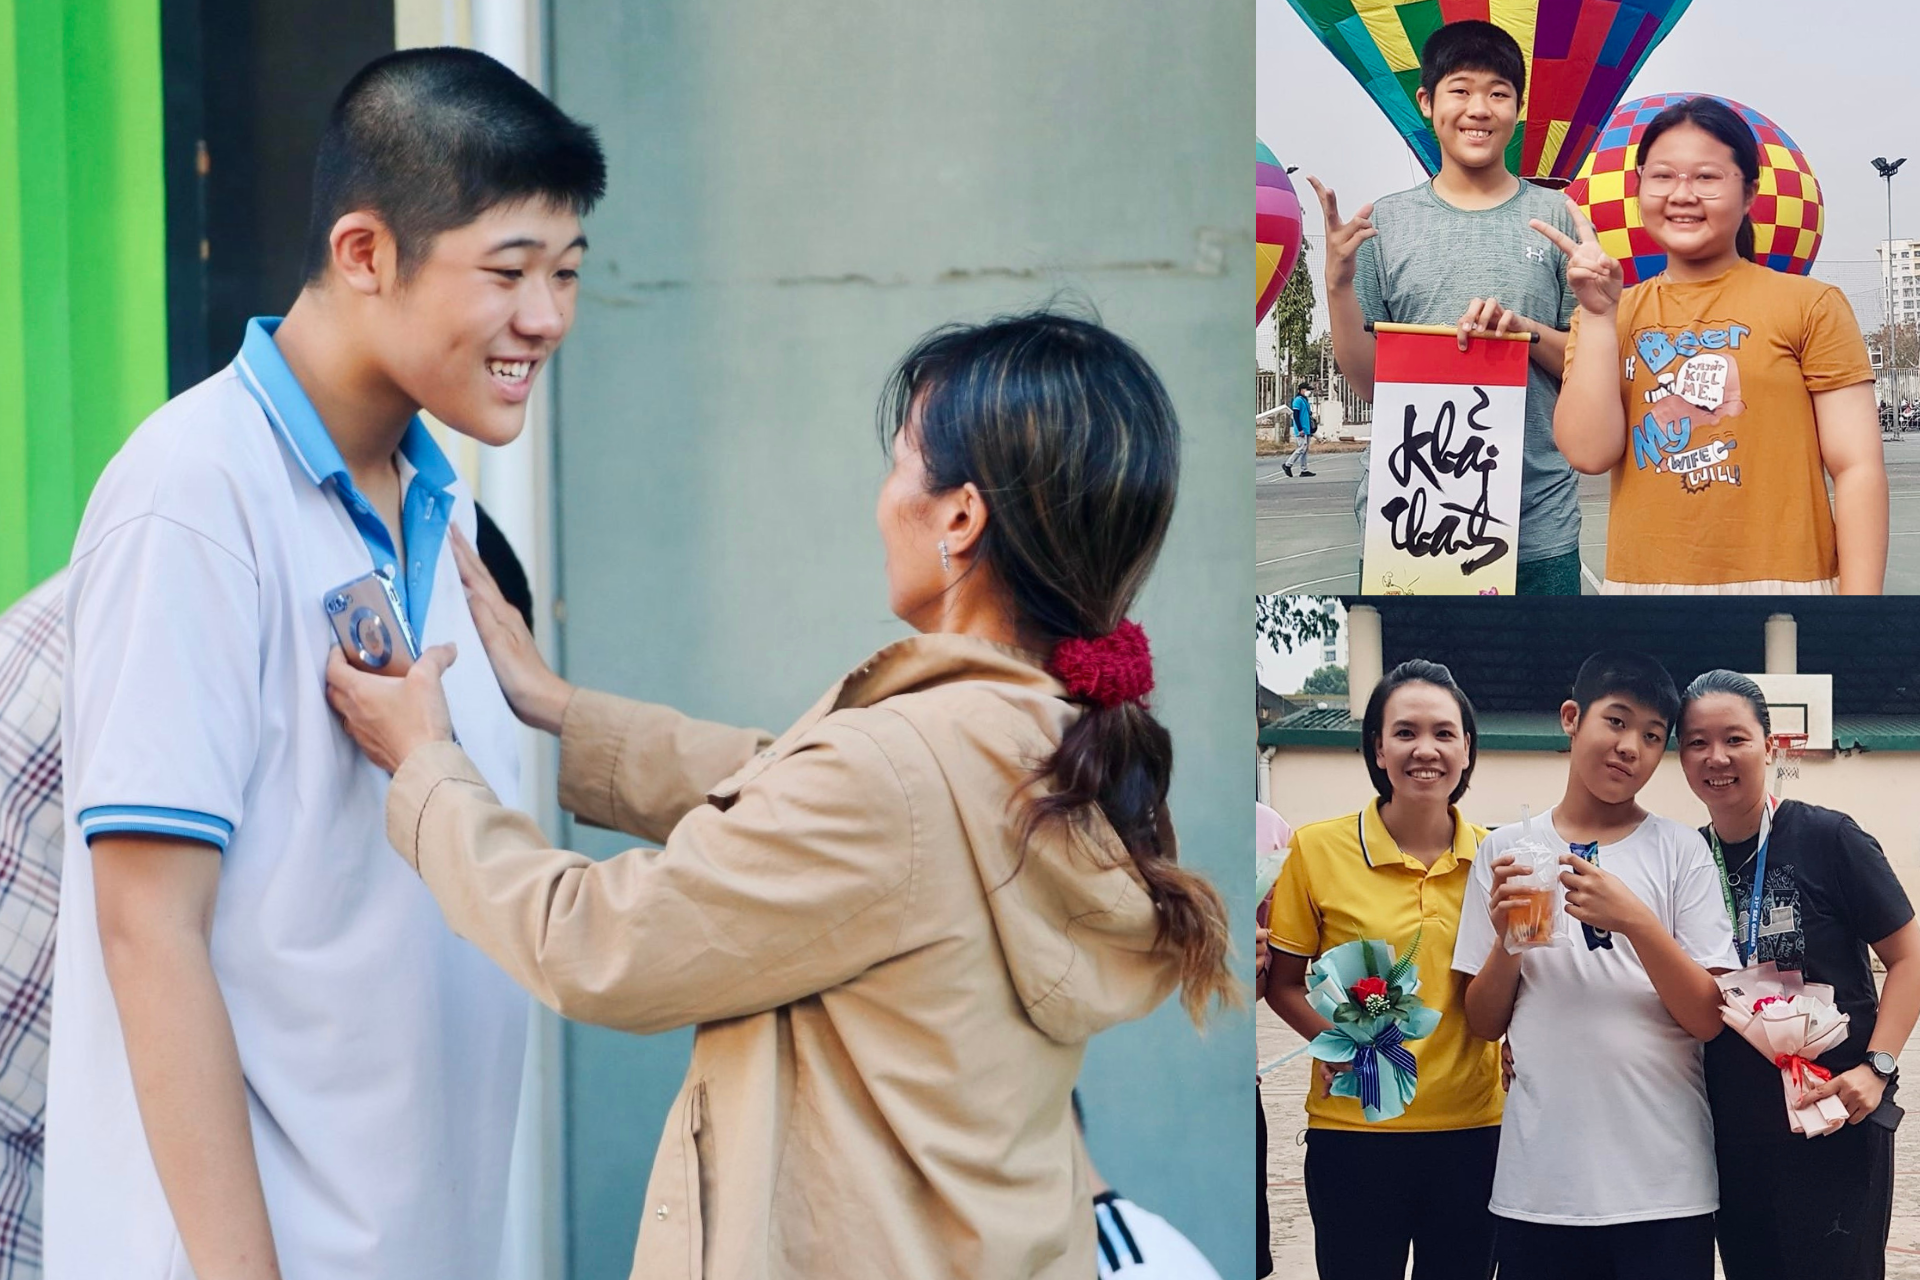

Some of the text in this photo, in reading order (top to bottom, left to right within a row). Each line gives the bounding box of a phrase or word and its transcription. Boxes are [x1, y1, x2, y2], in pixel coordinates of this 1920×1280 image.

[1637, 325, 1751, 375] Beer
[1684, 369, 1720, 385] KILL
[1671, 447, 1711, 470] WIFE
[1688, 464, 1741, 486] WILL!
[1750, 922, 1758, 947] GAMES
